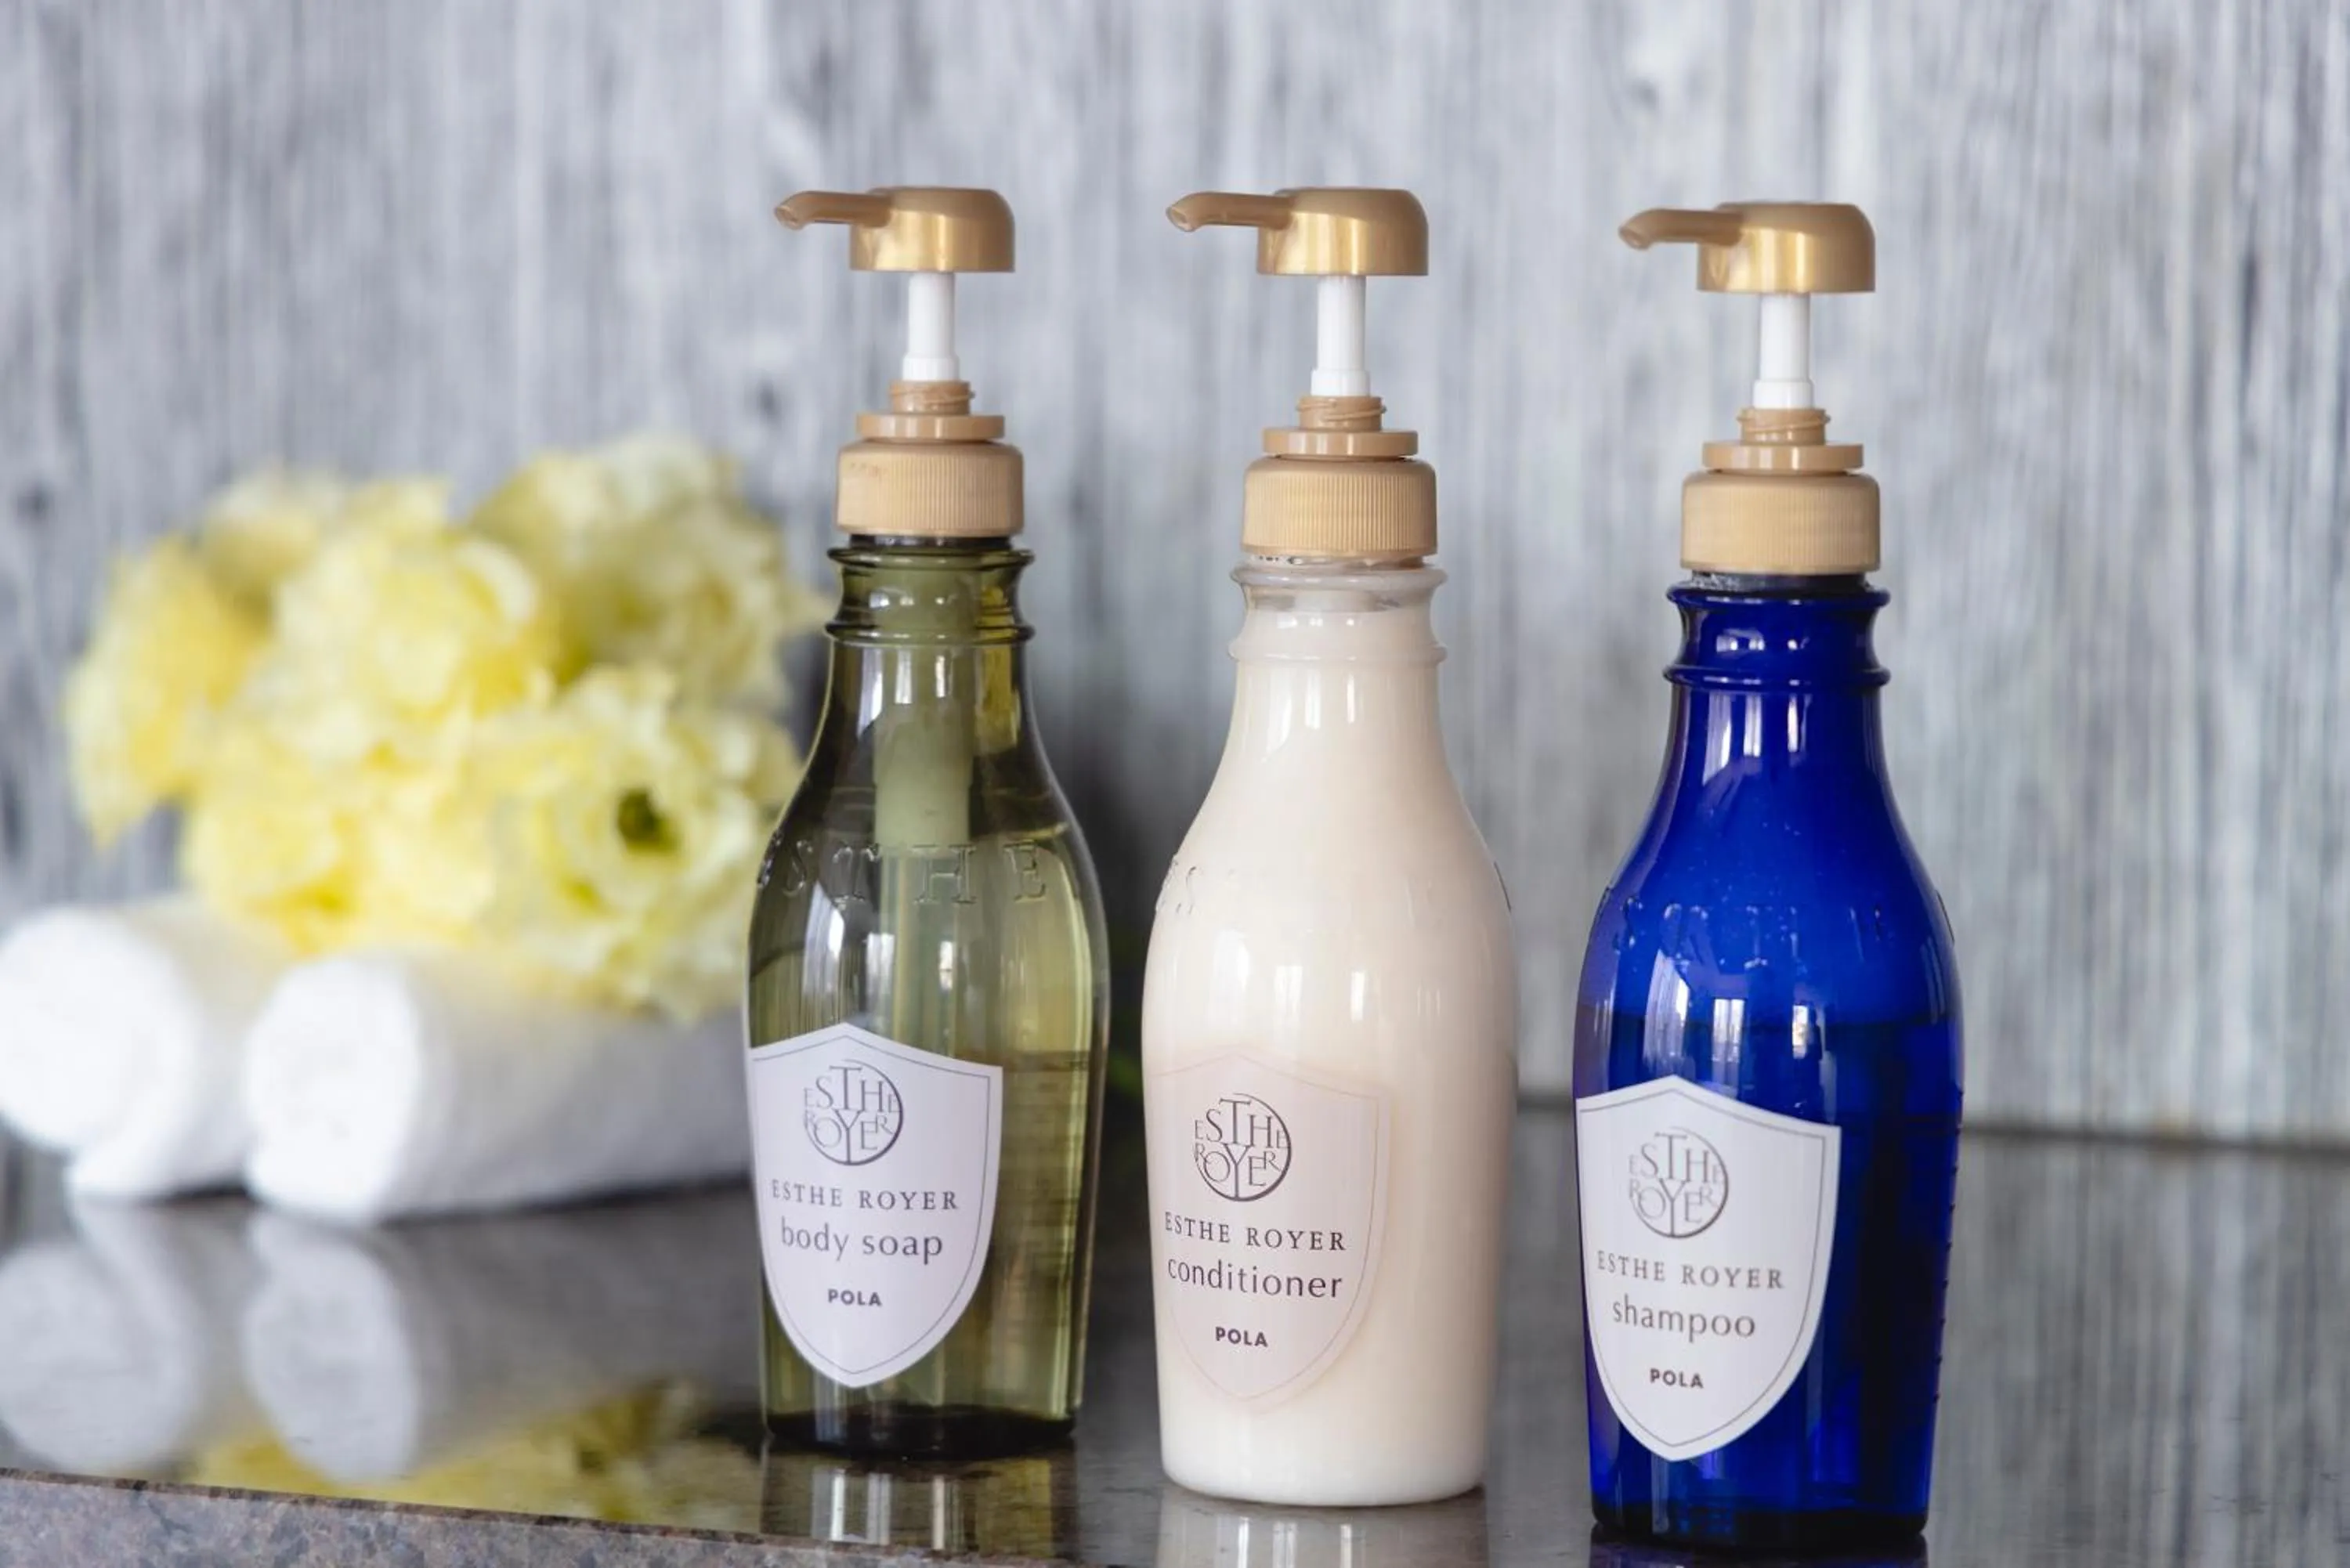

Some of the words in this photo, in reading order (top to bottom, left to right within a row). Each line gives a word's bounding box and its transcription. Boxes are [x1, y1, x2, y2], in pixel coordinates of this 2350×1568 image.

[804, 1065, 901, 1114] ESTHE
[804, 1109, 893, 1165] ROYER
[1194, 1098, 1291, 1149] ESTHE
[1194, 1143, 1281, 1200] ROYER
[1629, 1132, 1726, 1185] ESTHE
[772, 1179, 843, 1208] ESTHE
[859, 1189, 960, 1210] ROYER
[781, 1216, 849, 1261] body
[862, 1234, 942, 1265] soap
[1165, 1211, 1231, 1243] ESTHE
[1246, 1227, 1347, 1251] ROYER
[1168, 1258, 1343, 1299] conditioner
[1597, 1250, 1665, 1281] ESTHE
[1682, 1265, 1785, 1289] ROYER
[827, 1288, 883, 1307] POLA
[1612, 1293, 1755, 1343] shampoo
[1215, 1326, 1269, 1348] POLA
[1650, 1368, 1705, 1389] POLA
